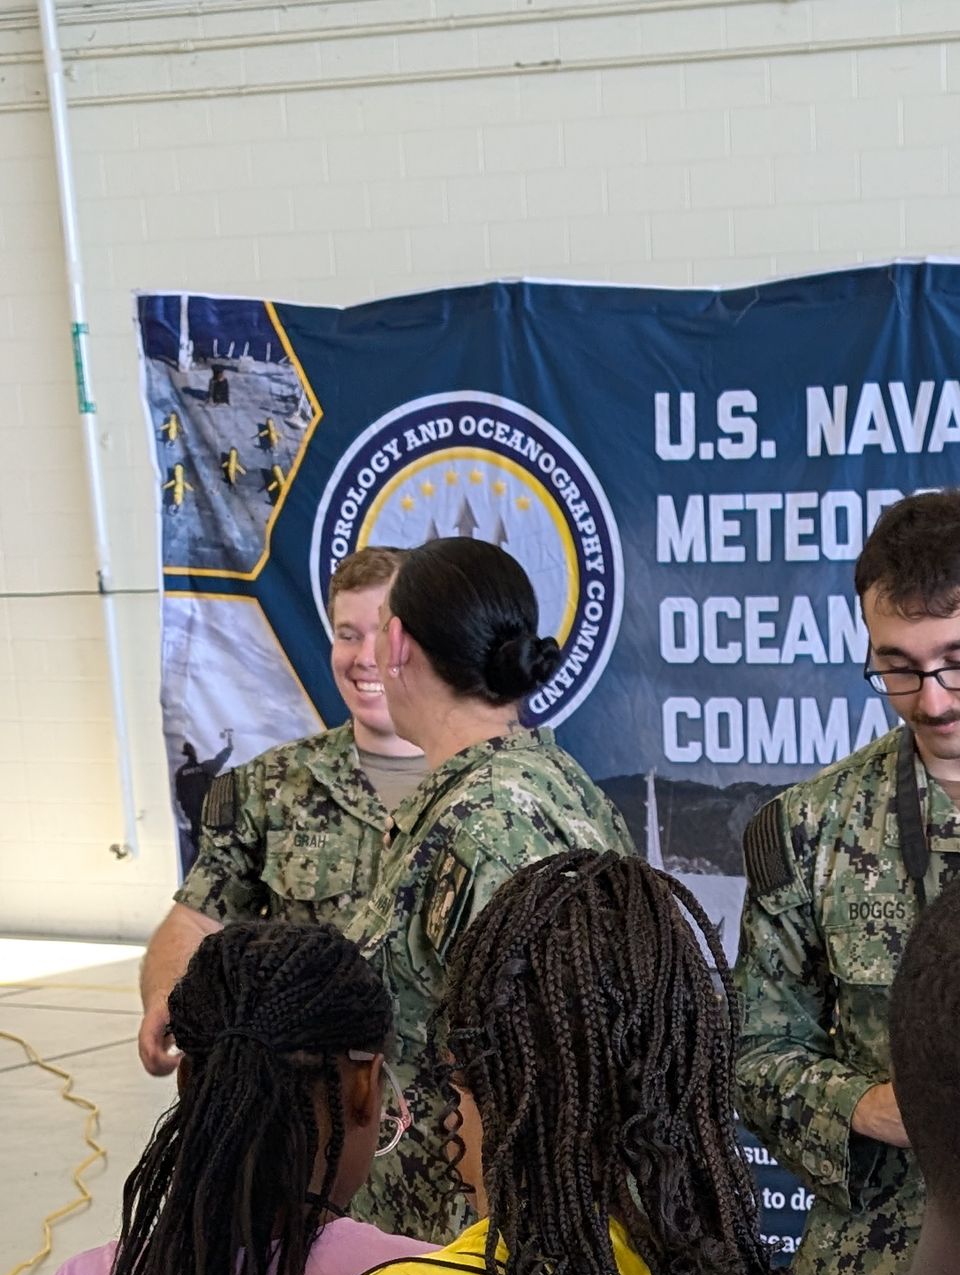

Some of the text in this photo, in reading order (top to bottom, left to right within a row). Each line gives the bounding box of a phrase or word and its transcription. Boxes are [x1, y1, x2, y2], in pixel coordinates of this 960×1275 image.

[654, 390, 777, 461] U.S.
[330, 415, 606, 715] OROLOGY AND OCEANOGRAPHY COMMAND
[662, 697, 904, 765] COMMA
[849, 901, 905, 920] BOGGS
[762, 1187, 786, 1209] to
